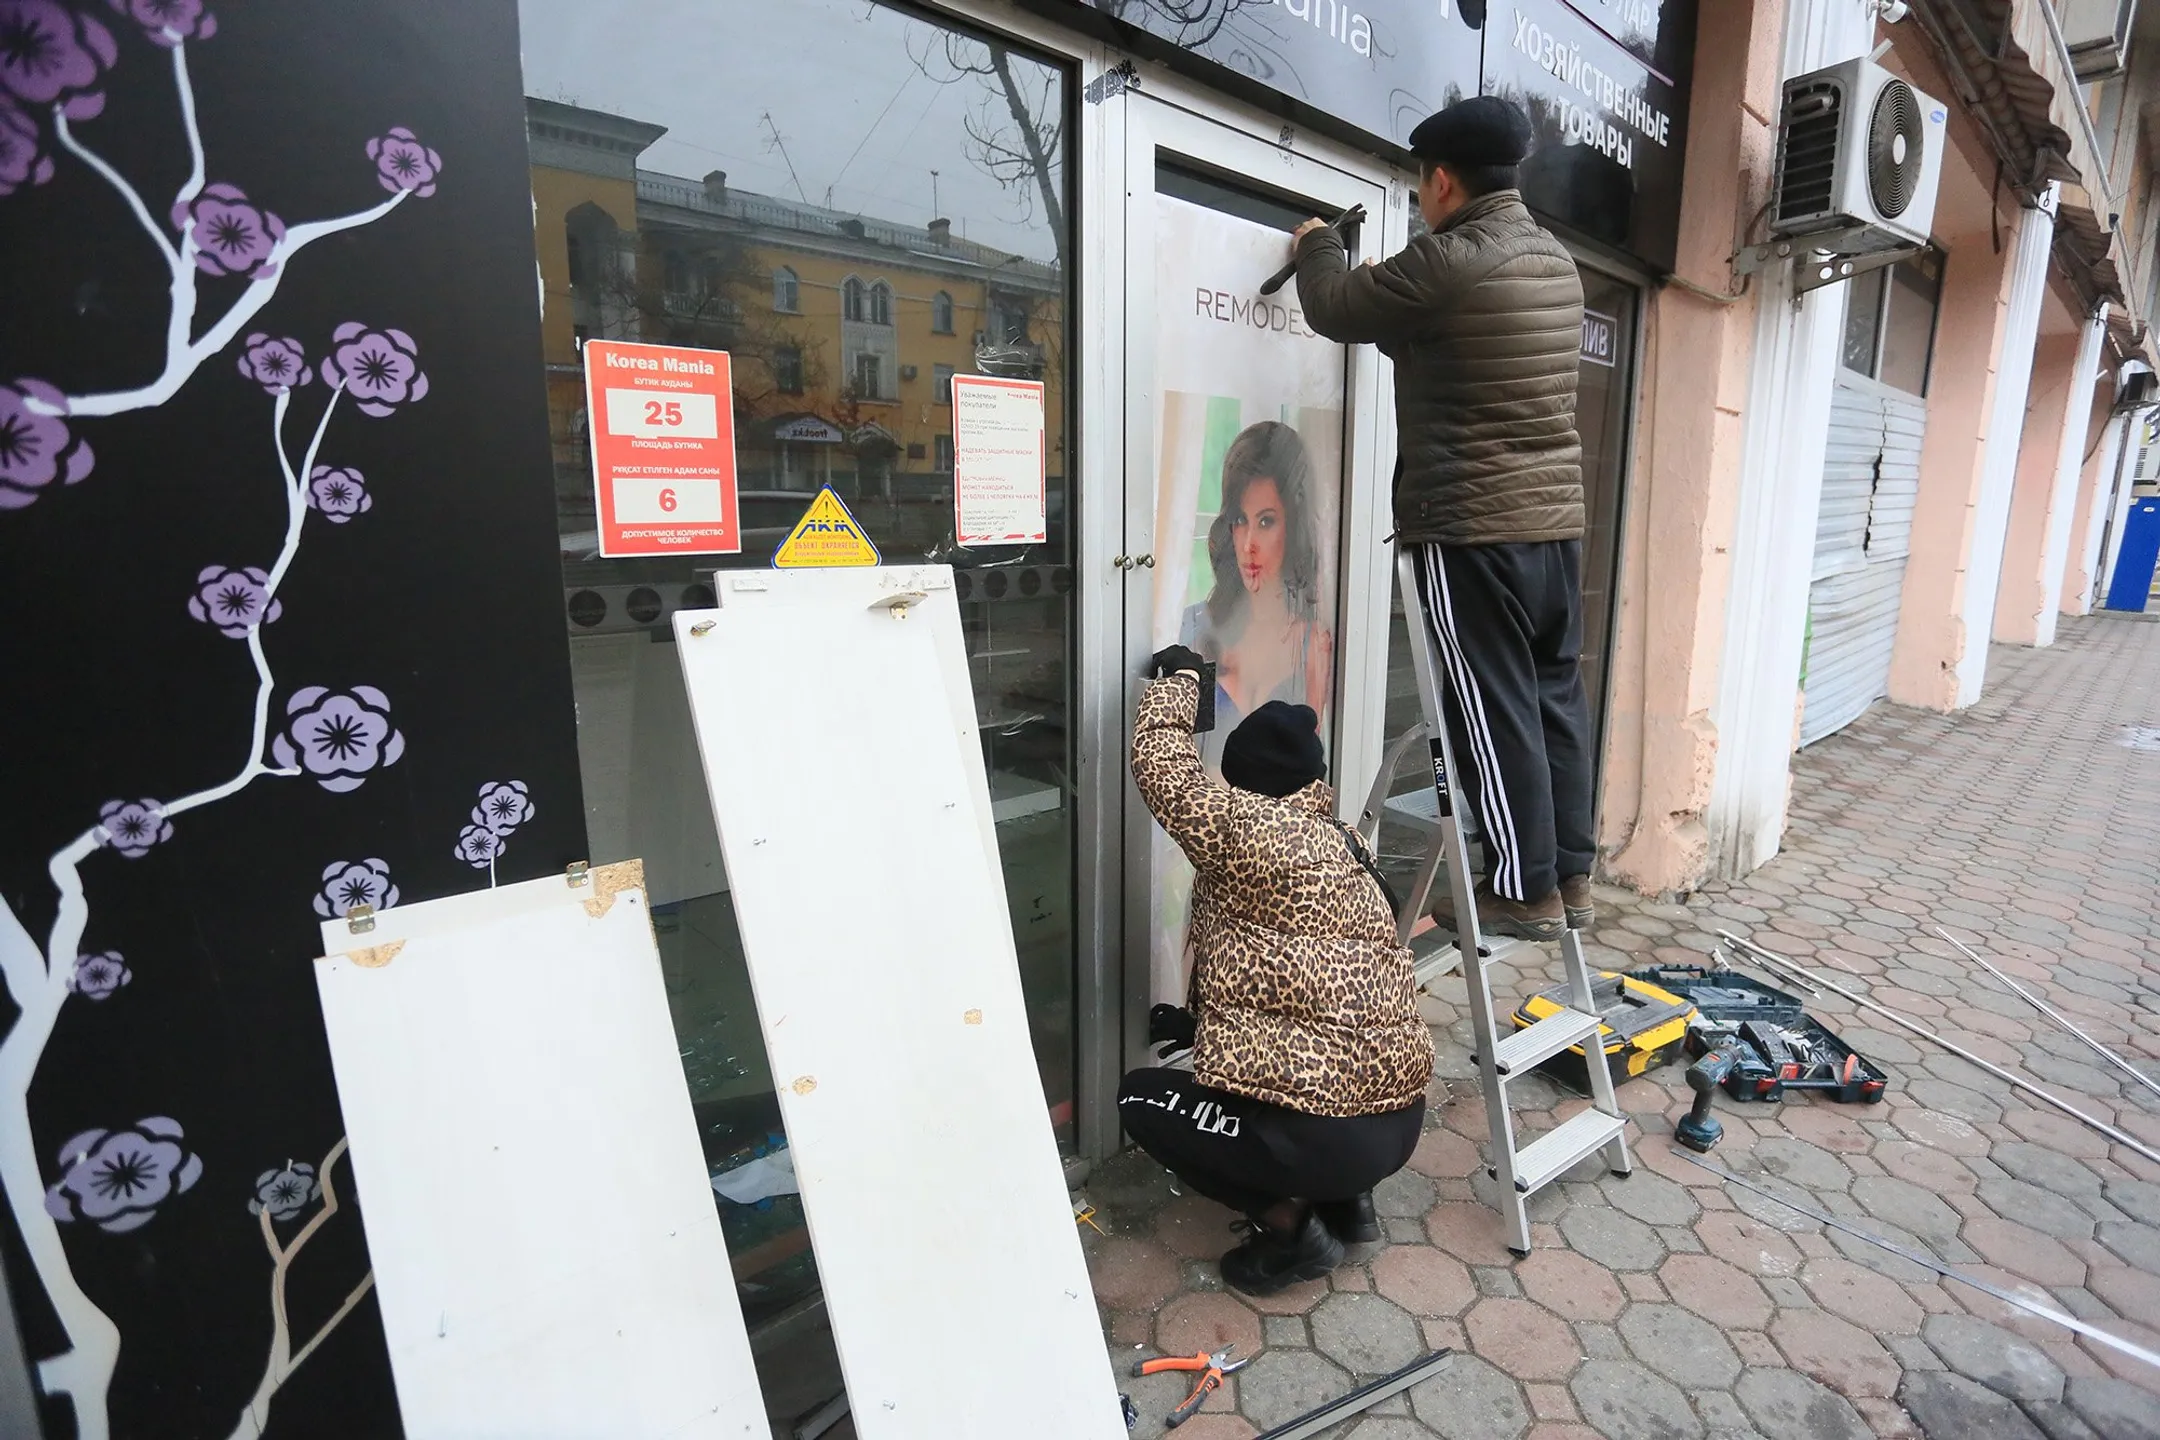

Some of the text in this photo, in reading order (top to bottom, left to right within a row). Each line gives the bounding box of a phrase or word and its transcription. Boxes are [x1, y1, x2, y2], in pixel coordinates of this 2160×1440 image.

[1512, 8, 1670, 148] ХОЗЯЙСТВЕННЫЕ
[1558, 95, 1632, 169] ТОВАРЫ
[1196, 287, 1316, 338] REMODE
[606, 352, 715, 375] Korea Mania
[634, 377, 693, 388] БУТИК АУДАНЫ
[644, 401, 683, 426] 25
[631, 440, 704, 450] ПЛОЩАДЬ БУТИКА
[673, 467, 697, 475] АДАМ
[698, 467, 720, 475] САНЫ
[659, 488, 677, 512] 6
[622, 529, 724, 539] ДОПУСТИМОЕ КОЛИЧЕСТВО
[1434, 757, 1448, 796] KROFT
